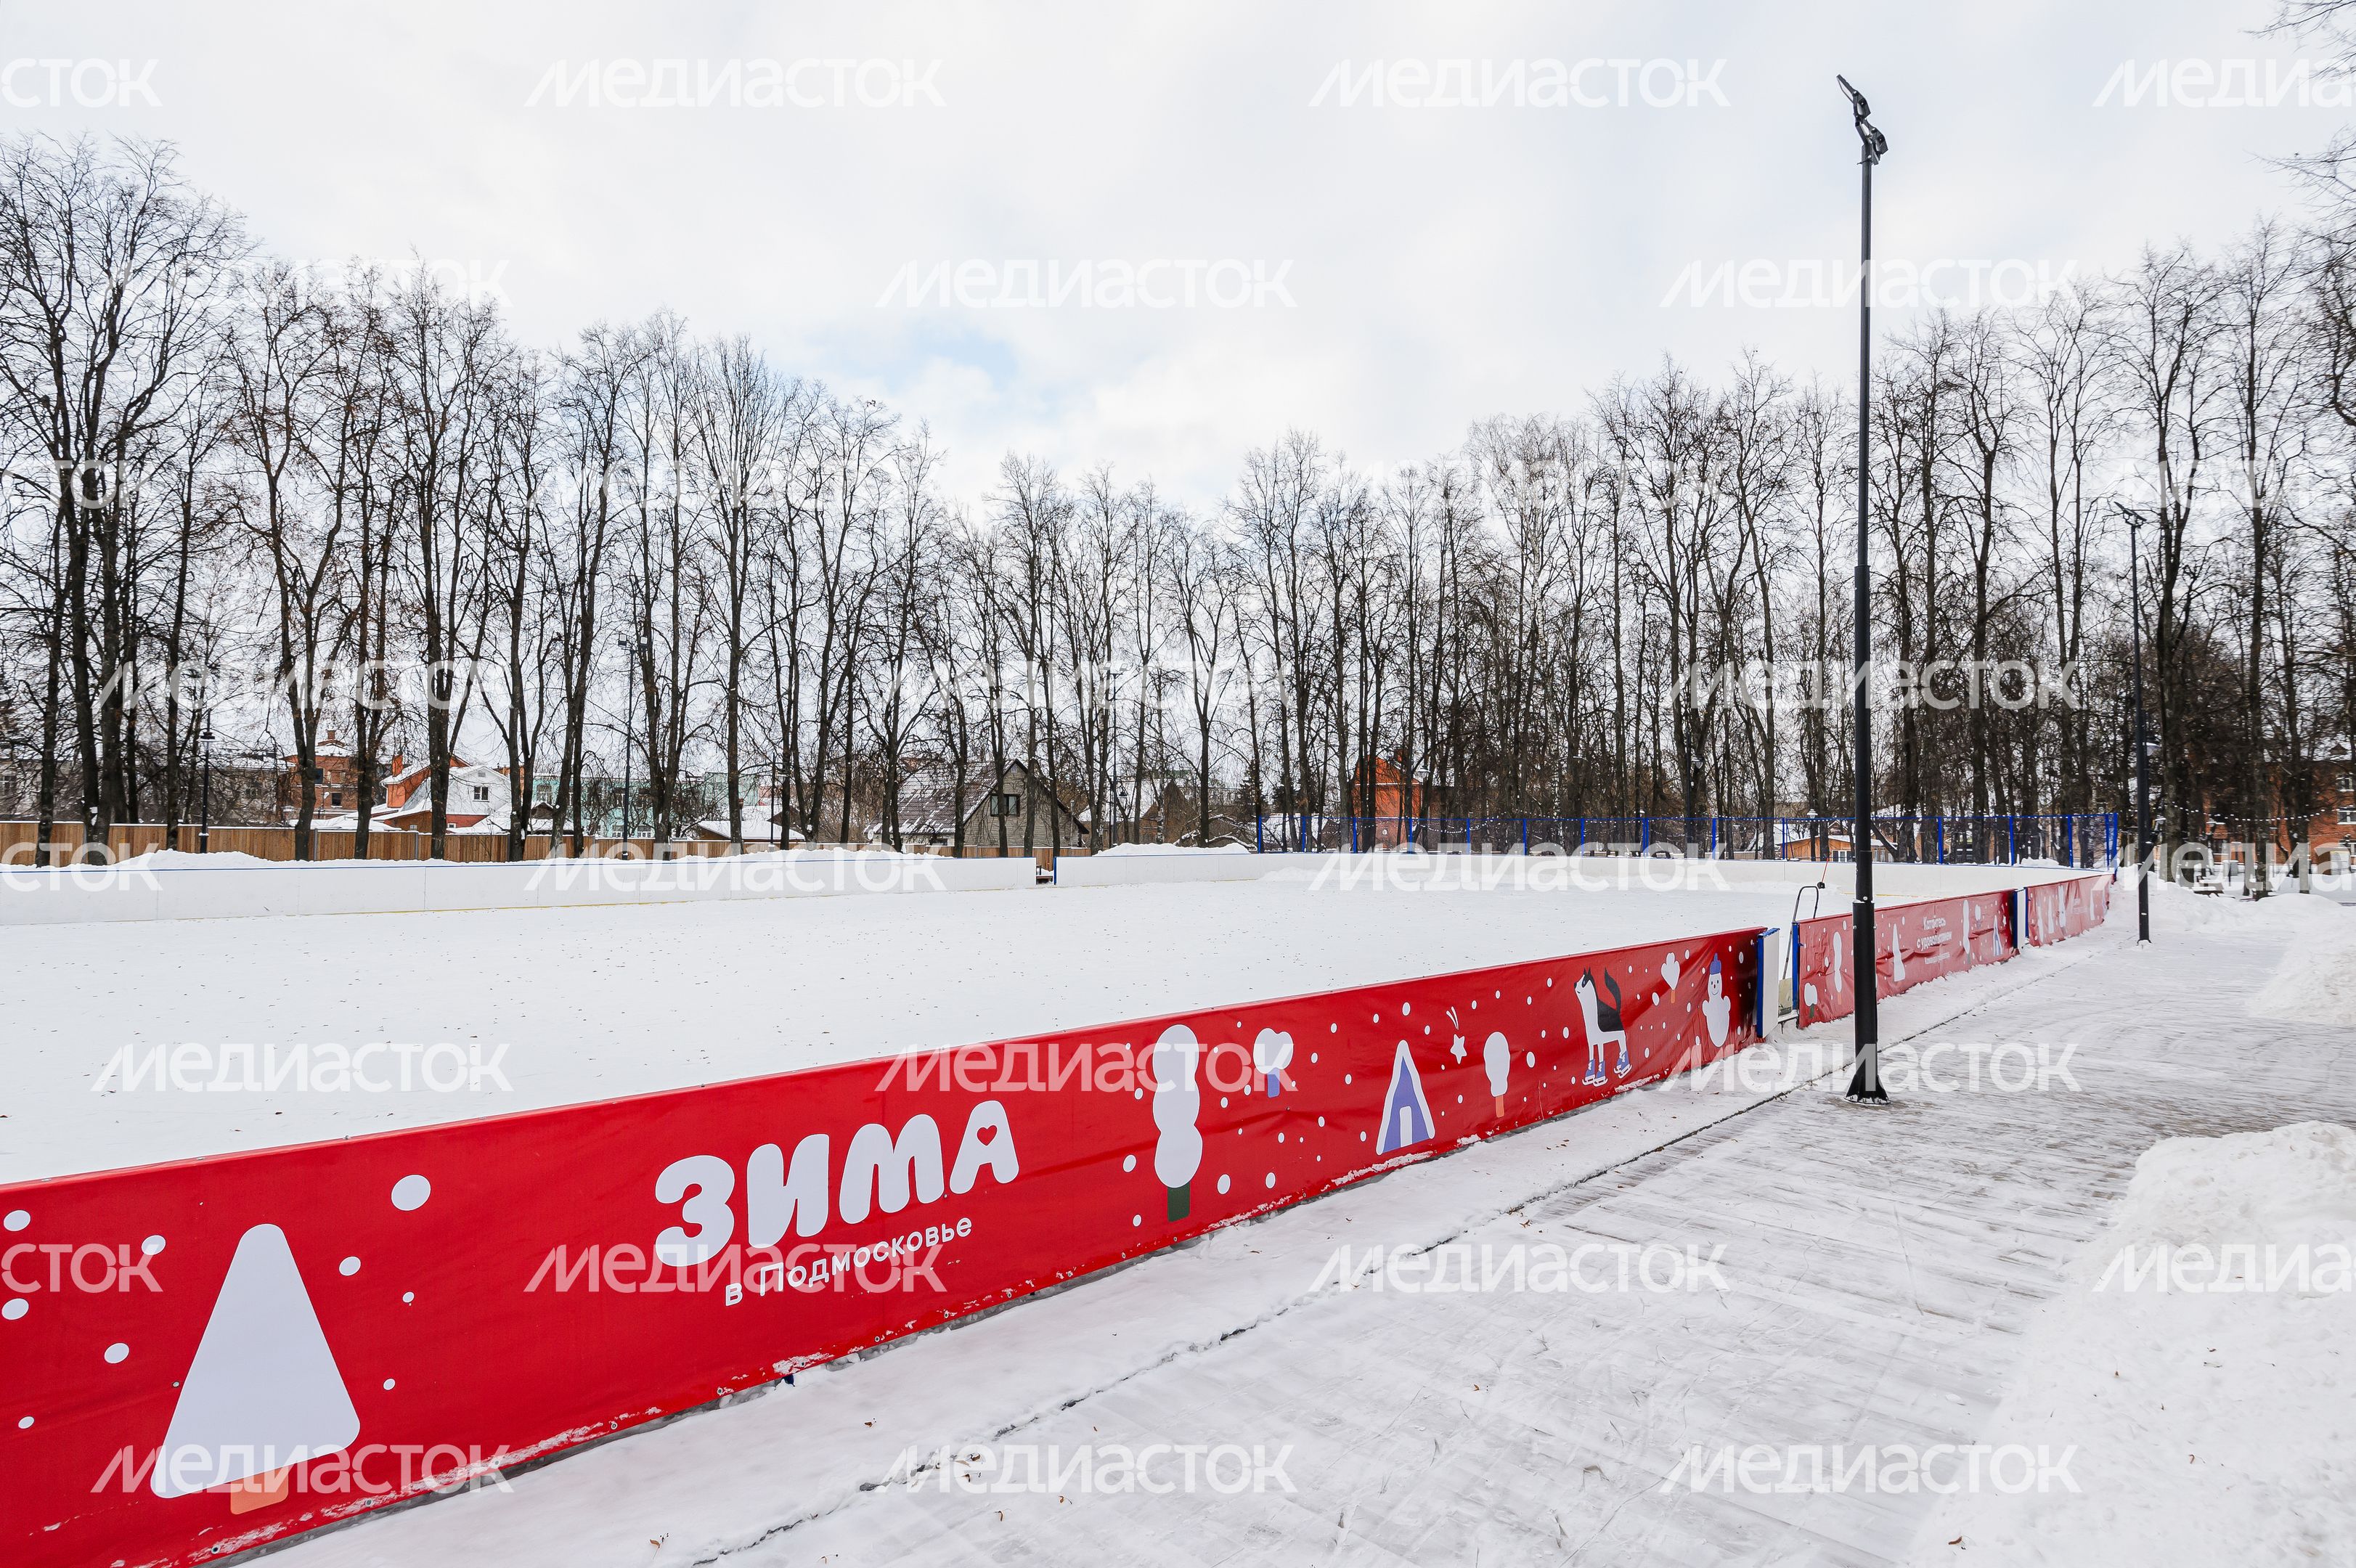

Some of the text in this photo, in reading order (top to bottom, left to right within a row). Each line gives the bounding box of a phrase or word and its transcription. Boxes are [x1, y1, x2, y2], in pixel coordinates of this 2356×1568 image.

[655, 1100, 1019, 1267] ЗИМА
[726, 1217, 973, 1307] в Подмосковье
